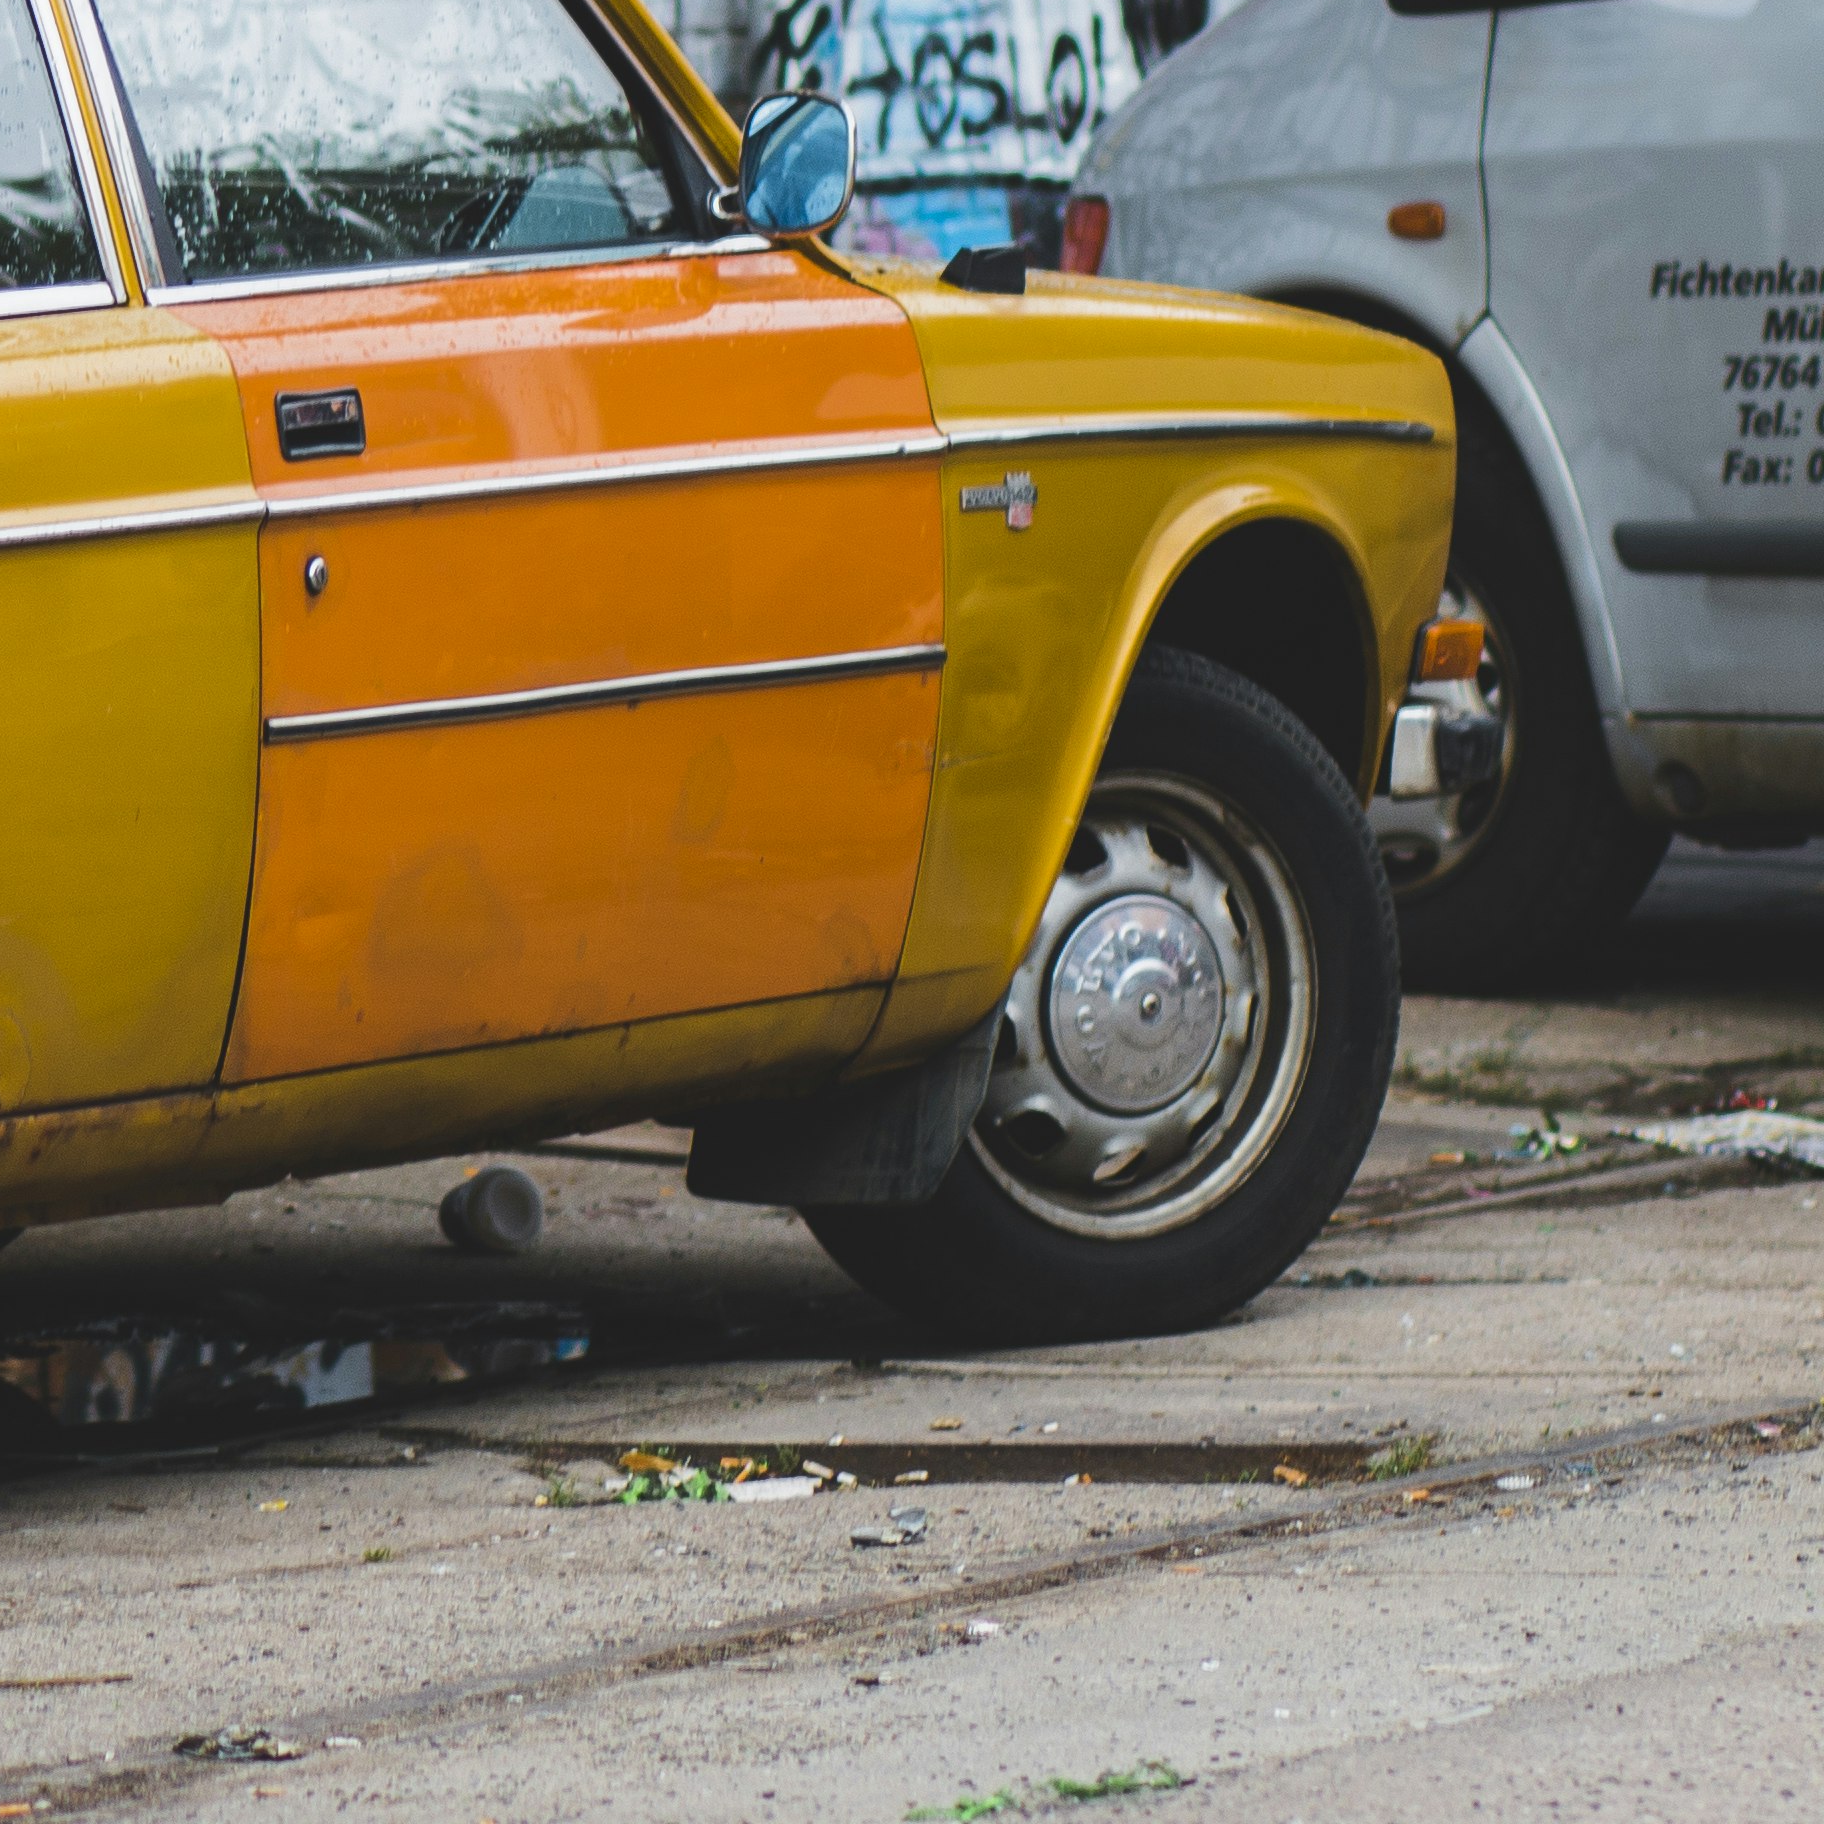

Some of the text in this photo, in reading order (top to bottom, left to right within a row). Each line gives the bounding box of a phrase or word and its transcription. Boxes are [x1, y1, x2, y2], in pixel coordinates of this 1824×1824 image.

[1722, 353, 1821, 392] 76764
[1738, 399, 1802, 439] Tel.:
[1722, 448, 1793, 485] Fax:
